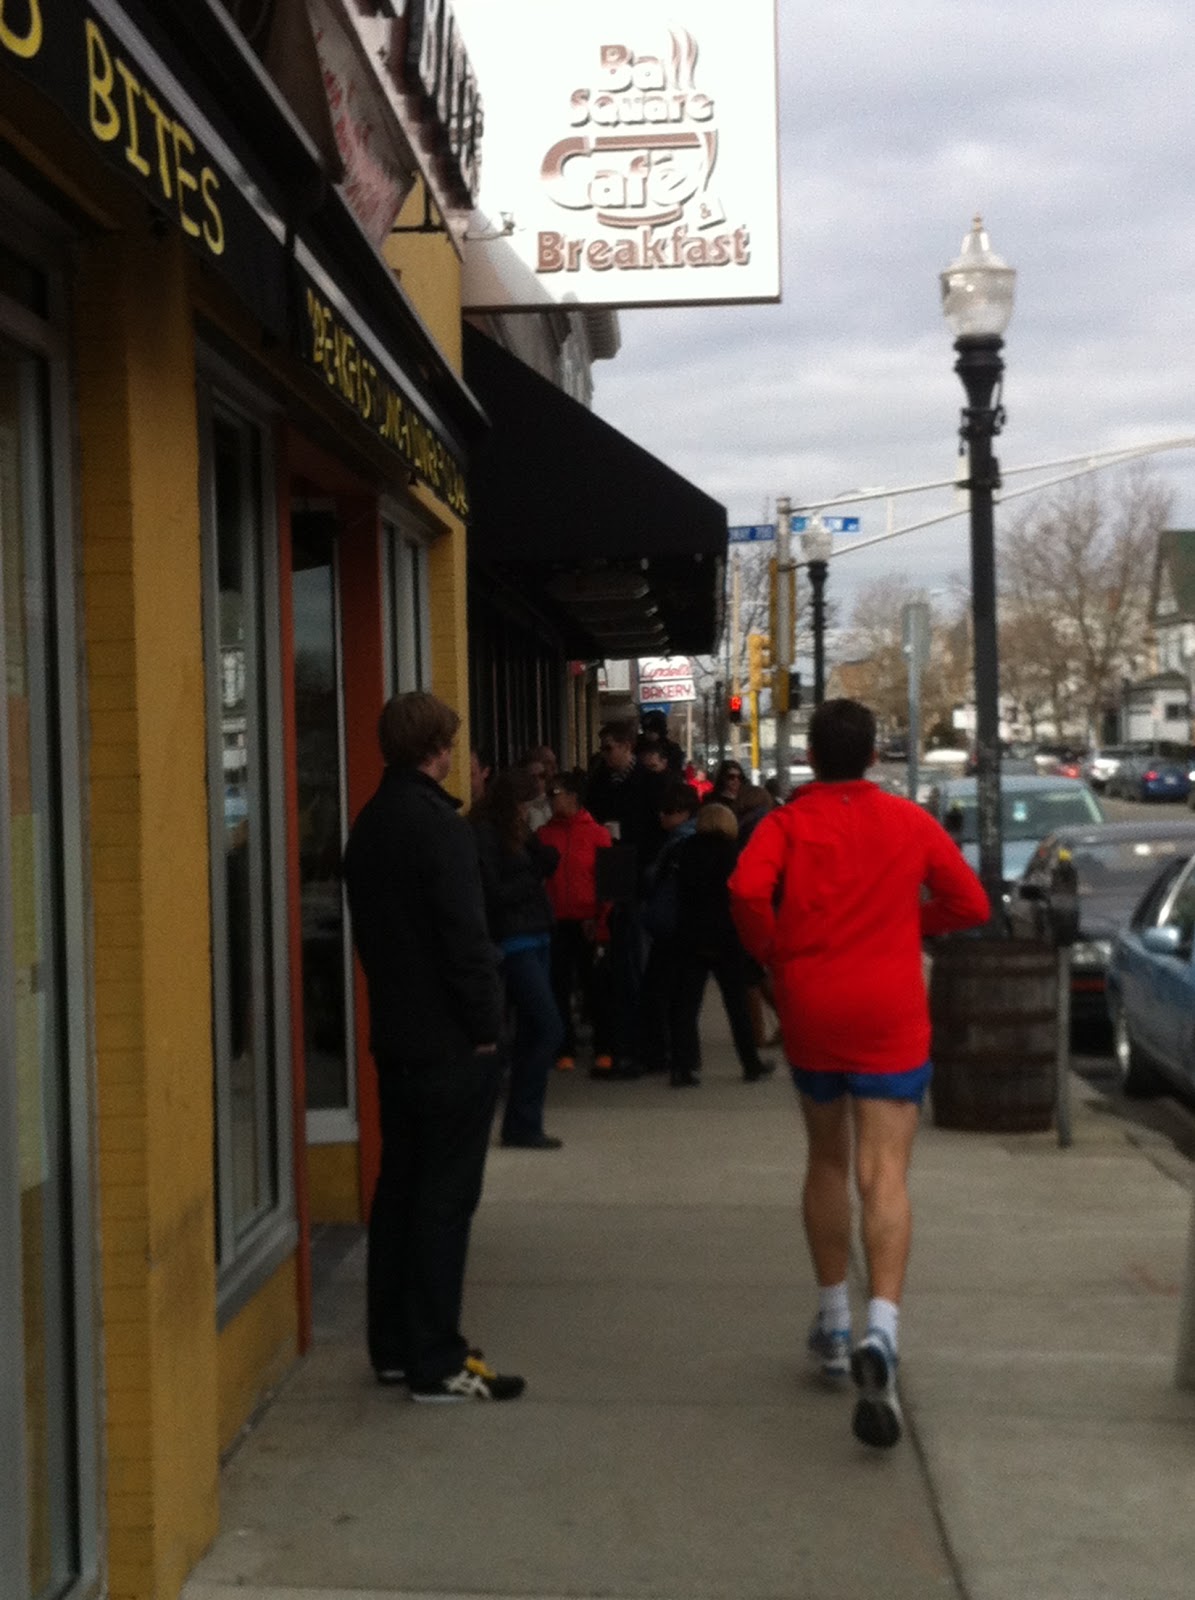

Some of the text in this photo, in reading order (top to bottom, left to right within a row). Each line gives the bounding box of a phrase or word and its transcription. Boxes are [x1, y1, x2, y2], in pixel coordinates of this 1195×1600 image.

[599, 22, 699, 92] Ball
[570, 88, 714, 127] Square
[86, 18, 225, 256] BITES
[535, 224, 750, 274] Breakfast
[641, 683, 692, 700] BAKERY
